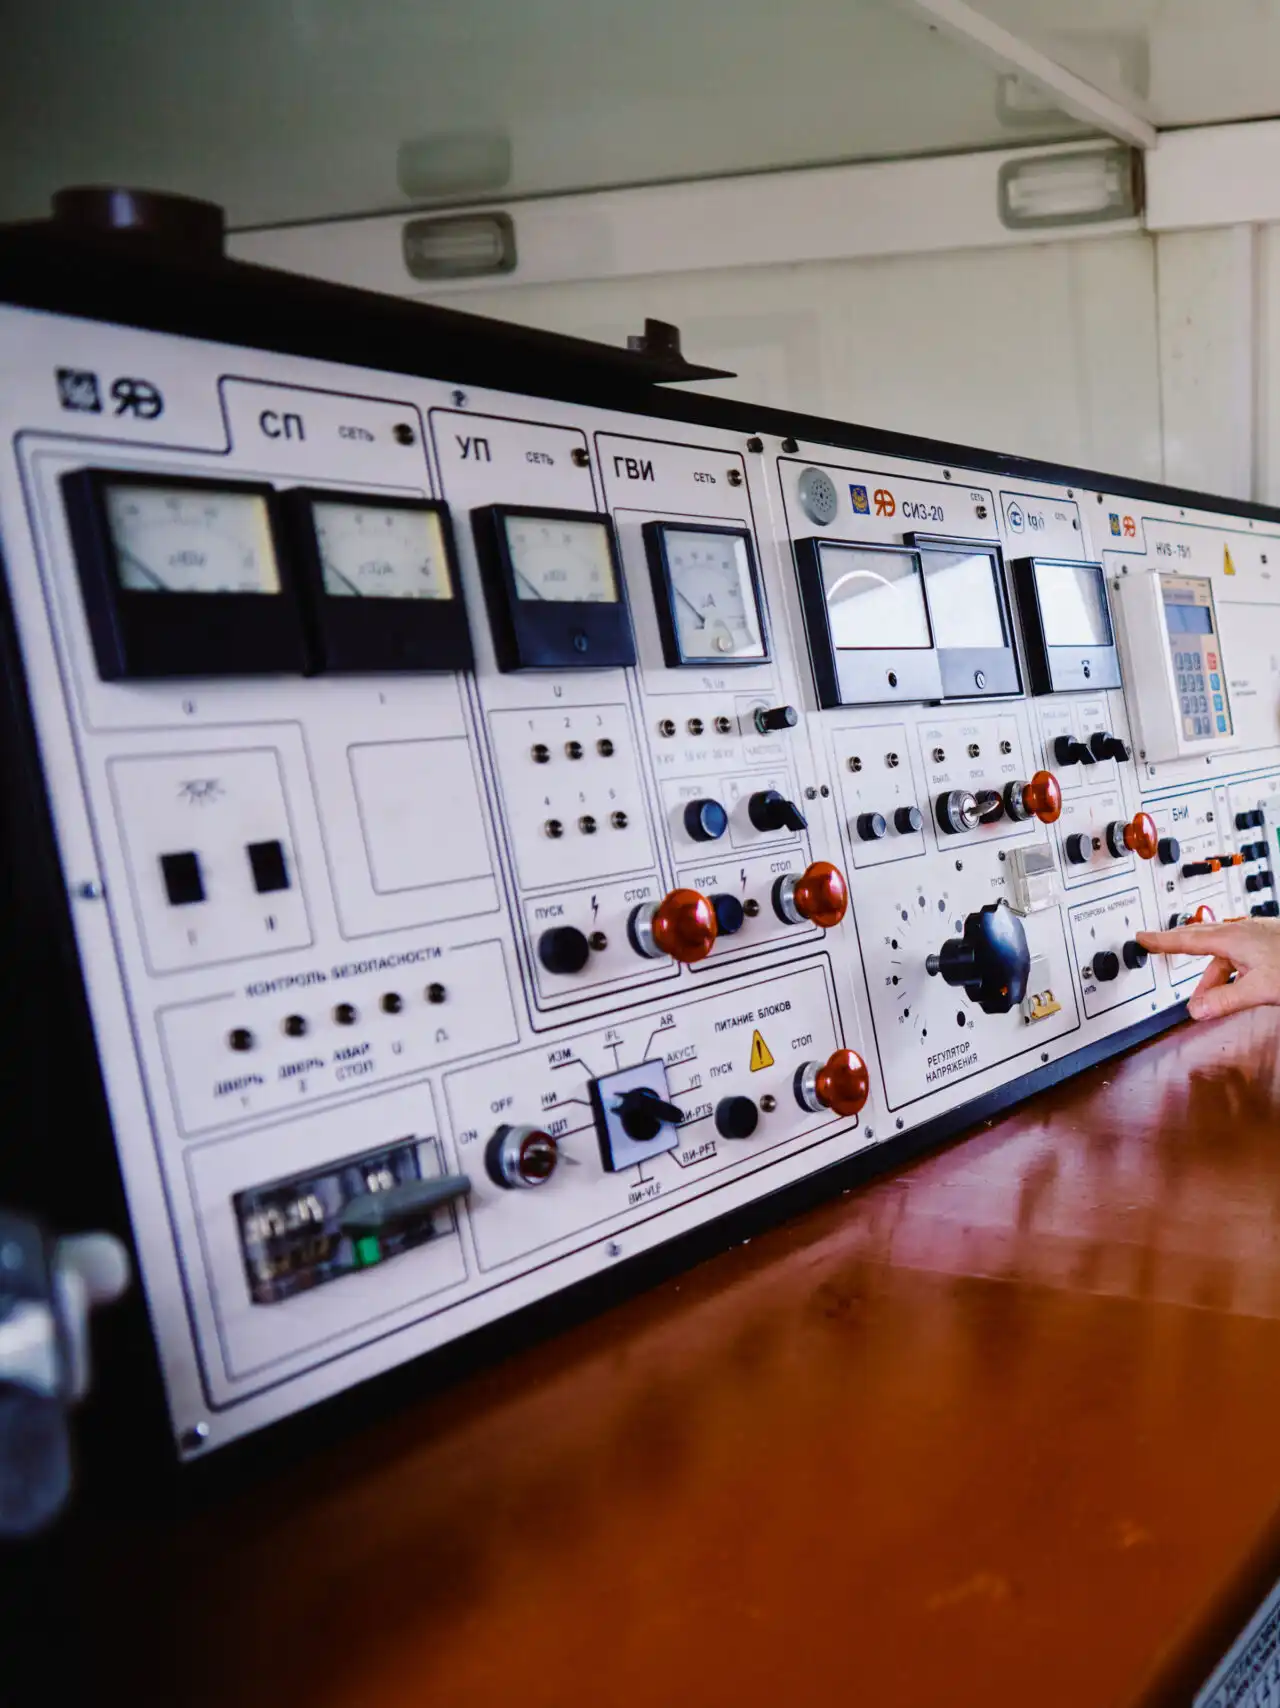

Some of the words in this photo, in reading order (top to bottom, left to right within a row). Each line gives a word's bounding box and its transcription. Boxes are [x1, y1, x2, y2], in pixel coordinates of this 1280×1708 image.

[260, 410, 304, 440] СП
[339, 426, 375, 441] СЕТЬ
[456, 435, 491, 461] УП
[525, 450, 555, 466] СЕТЬ
[613, 455, 655, 481] ГВИ
[693, 471, 716, 484] СЕТЬ
[970, 492, 985, 502] СЕТЬ
[902, 501, 944, 521] СИЗ-20
[1172, 804, 1189, 822] БНИ
[770, 860, 792, 873] СТОП
[694, 875, 718, 889] ПУСК
[623, 887, 651, 902] СТОП
[534, 905, 565, 920] ПУСК
[245, 971, 326, 998] КОНТРОЛЬ
[330, 947, 441, 980] БЕЗОПАСНОСТИ
[660, 1014, 674, 1027] AR
[714, 1011, 754, 1033] ПИТАНИЕ
[758, 1000, 791, 1019] БЛОКОВ
[605, 1030, 620, 1042] IFL
[791, 1034, 812, 1050] СТОП
[927, 1041, 970, 1068] РЕГУЛЯТОР
[280, 1058, 324, 1080] ДВЕРЬ
[336, 1060, 374, 1082] СТОП
[709, 1062, 733, 1077] ПУСК
[925, 1053, 978, 1083] НАПРЯЖЕНИЯ
[213, 1074, 264, 1098] ДВЕРЬ
[689, 1073, 701, 1087] УП
[490, 1096, 513, 1113] OFF
[540, 1091, 557, 1105] НИ
[459, 1130, 478, 1145] ON
[682, 1140, 716, 1163] ВИ-PFT
[628, 1182, 662, 1204] ВИ-VLF
